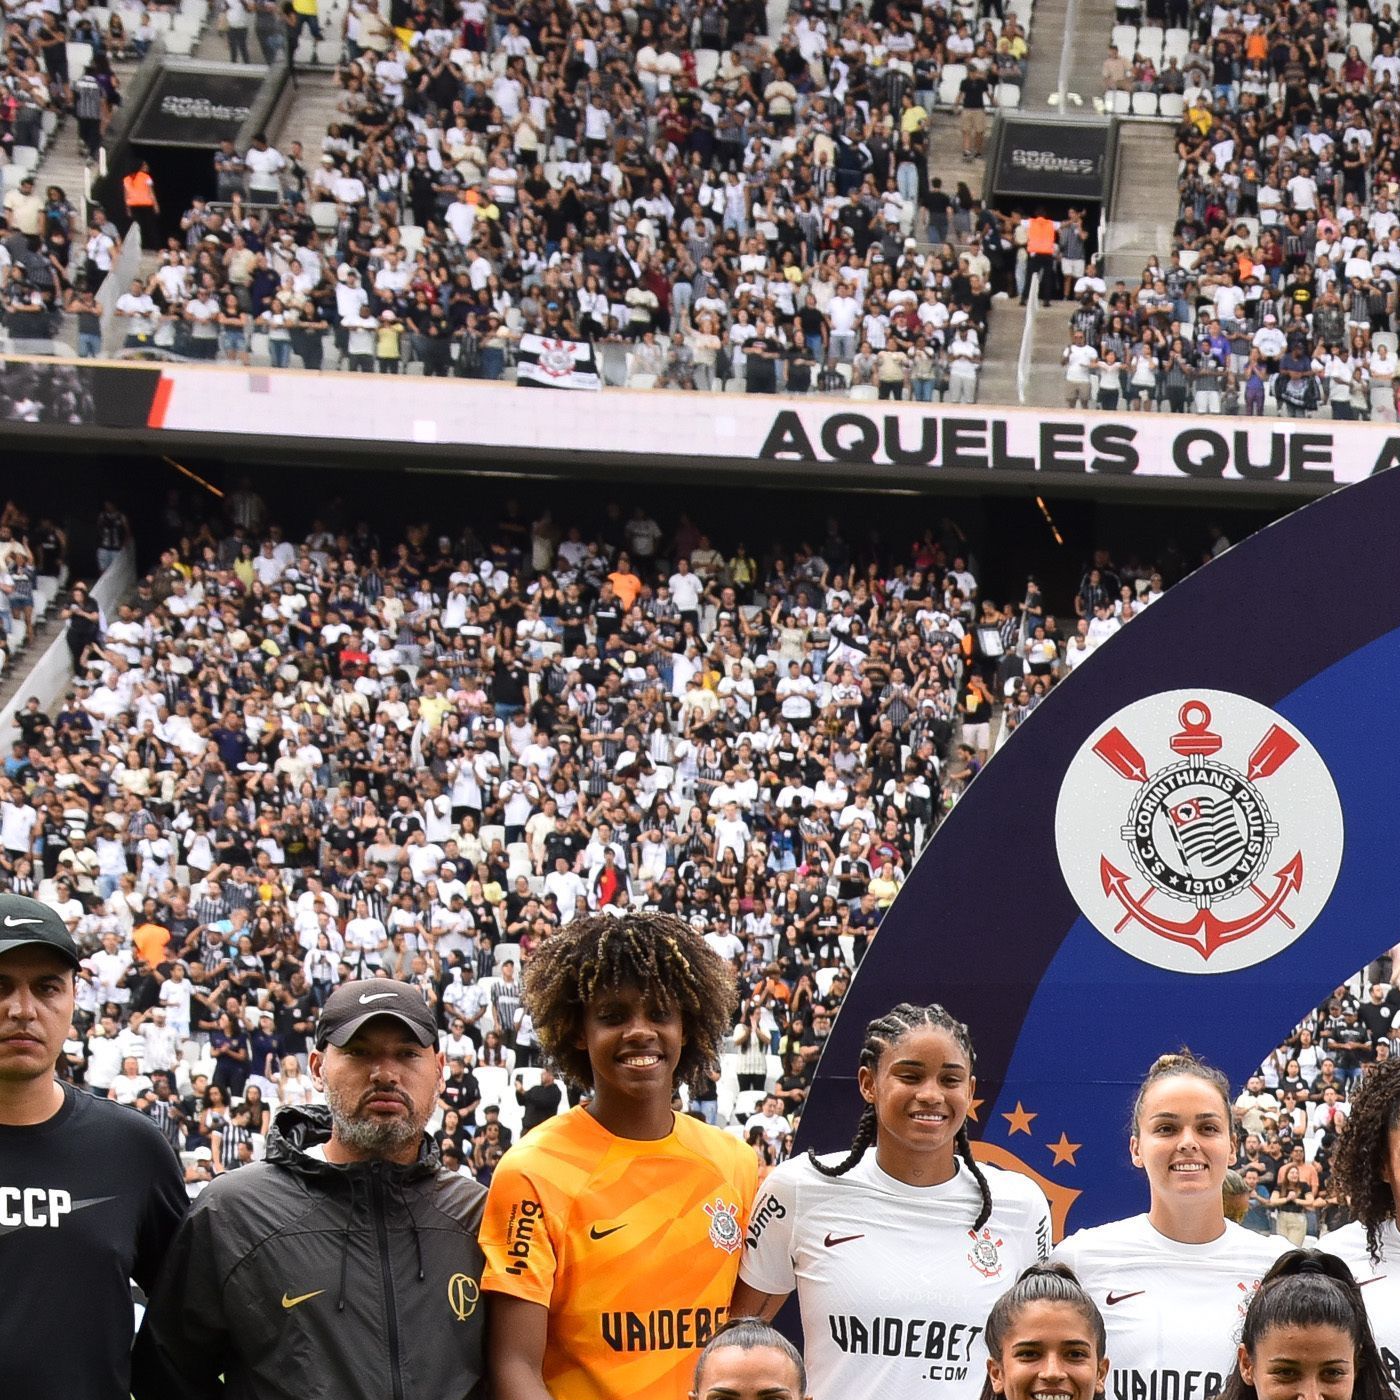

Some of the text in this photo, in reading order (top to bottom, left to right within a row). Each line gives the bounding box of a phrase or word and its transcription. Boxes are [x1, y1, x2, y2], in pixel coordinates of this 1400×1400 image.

[759, 410, 1139, 476] AQUELES
[1172, 427, 1334, 483] QUE
[1136, 768, 1236, 838] CORINTHIANS
[1234, 788, 1263, 875] PAULISTA
[1184, 878, 1226, 893] 1910
[514, 1199, 544, 1258] bmg
[748, 1194, 787, 1241] bmg
[601, 1306, 731, 1351] VAIDEBE
[829, 1314, 983, 1362] VAIDEBET
[922, 1366, 968, 1381] .COM
